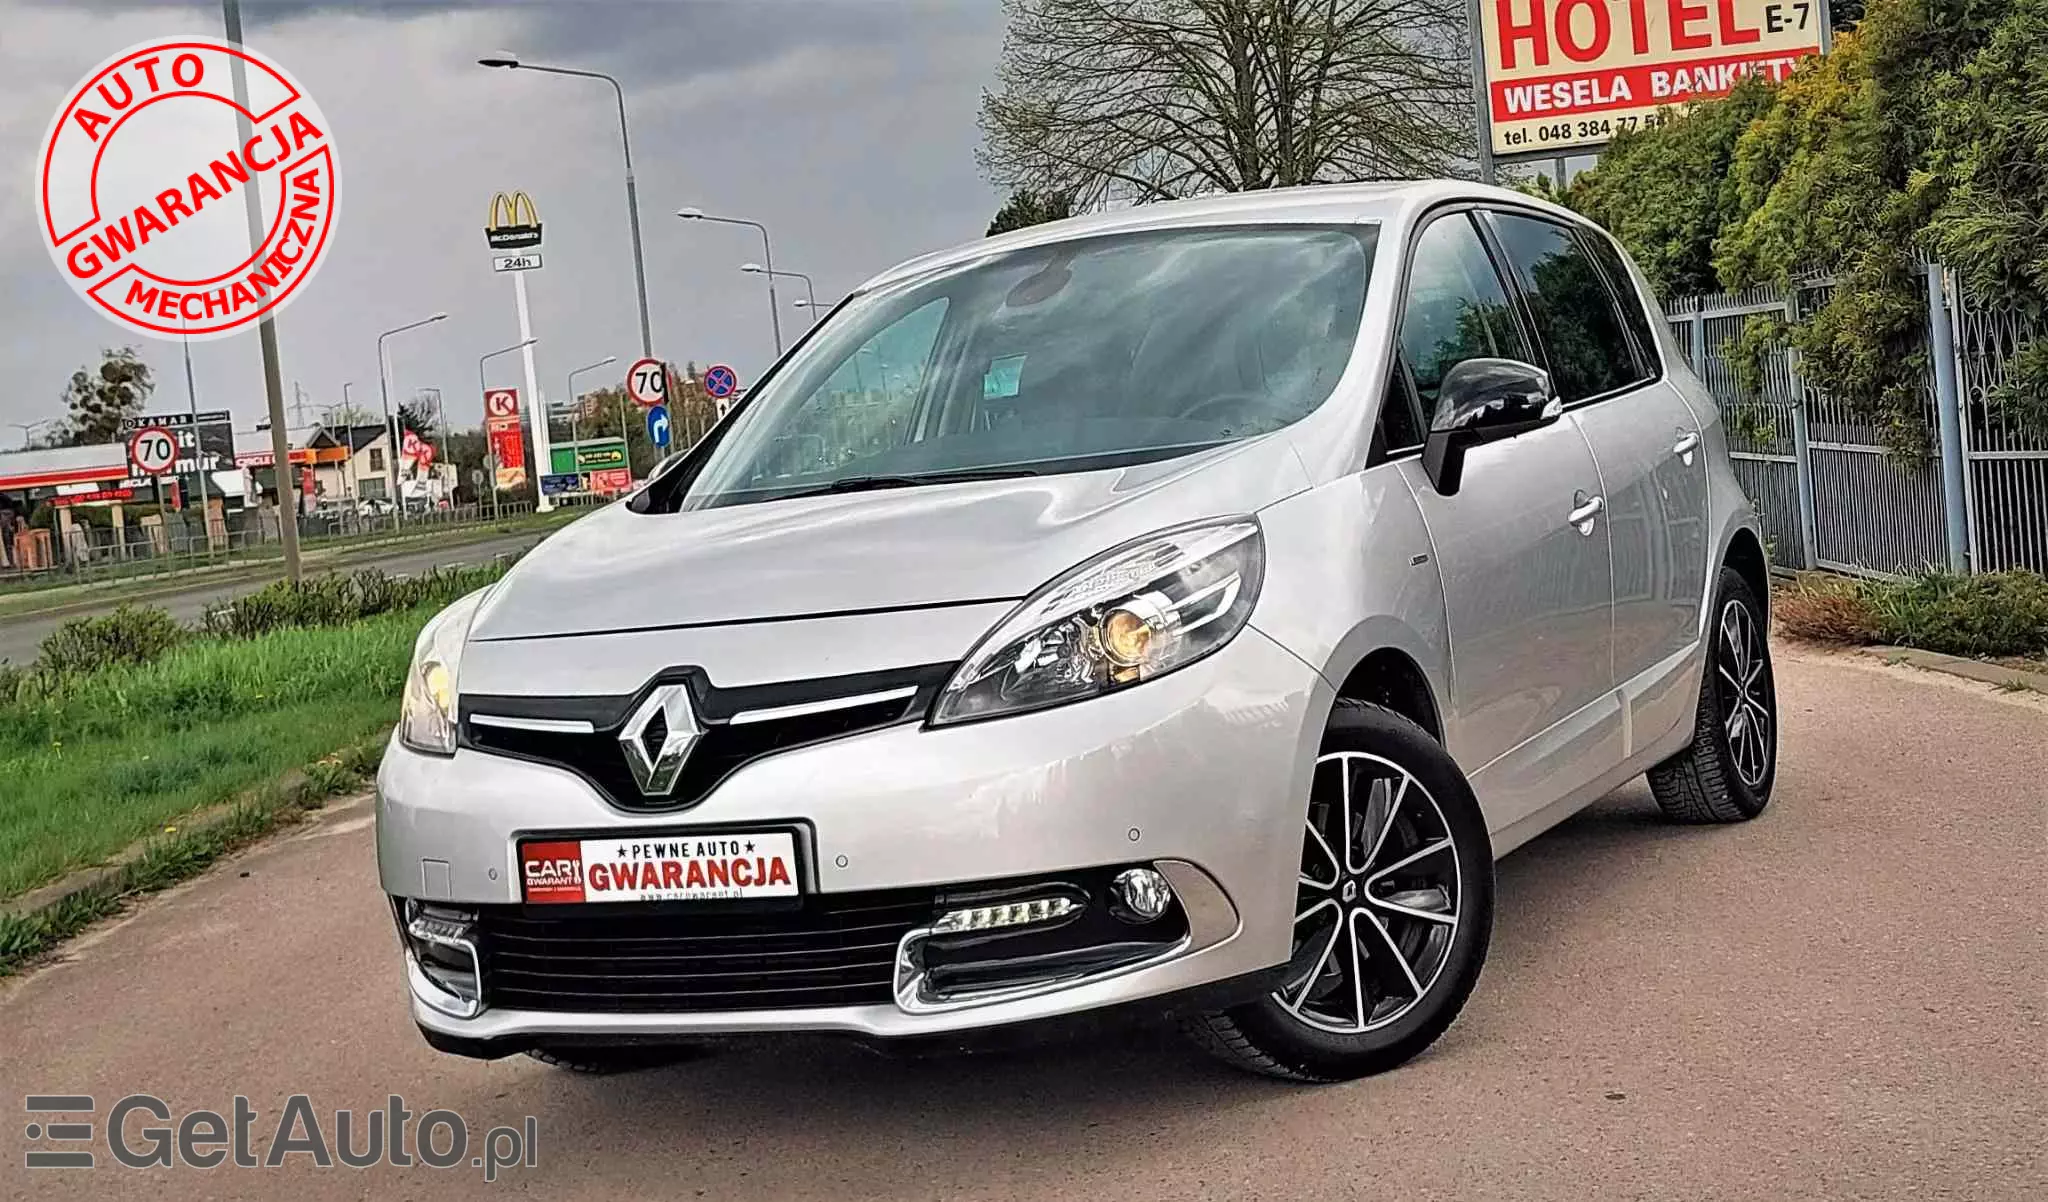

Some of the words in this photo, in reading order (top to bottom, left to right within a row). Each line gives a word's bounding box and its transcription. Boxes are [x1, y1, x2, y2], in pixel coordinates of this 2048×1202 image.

[1498, 0, 1760, 69] HOTEL
[1766, 3, 1809, 33] E-7
[1504, 75, 1632, 113] WESELA
[1504, 127, 1532, 145] tel.
[1538, 123, 1572, 141] 048
[1577, 119, 1610, 138] 384
[504, 257, 531, 269] 24h
[635, 371, 663, 395] 70
[140, 438, 170, 461] 70
[632, 843, 690, 859] PEWNE
[697, 841, 739, 856] AUTO
[525, 860, 572, 877] CAR
[589, 857, 791, 891] GWARANCJA
